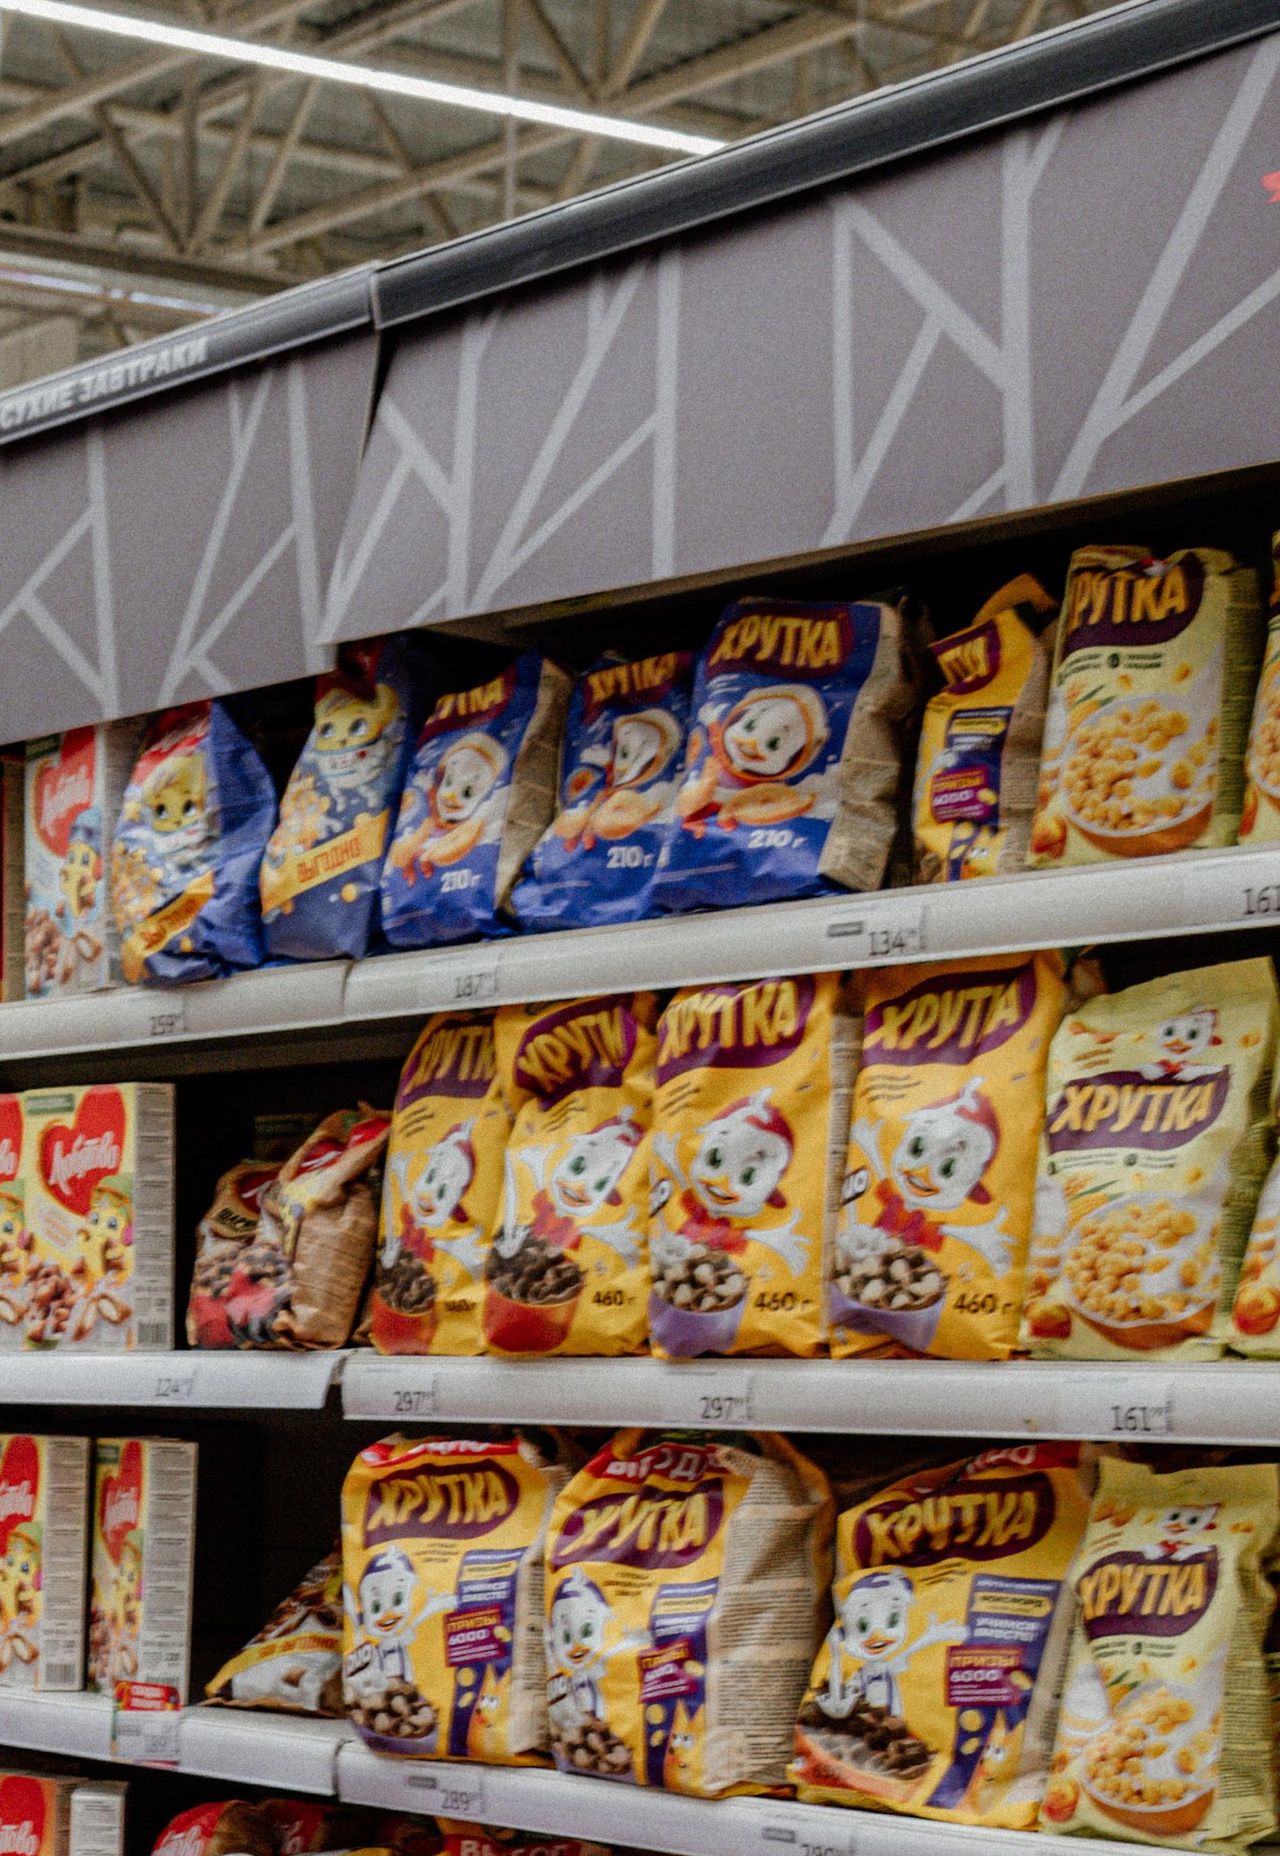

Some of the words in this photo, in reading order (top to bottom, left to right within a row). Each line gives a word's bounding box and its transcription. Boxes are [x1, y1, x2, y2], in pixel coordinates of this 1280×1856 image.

[0, 383, 78, 430] СУХИЕ
[79, 338, 209, 402] ЗАВТРАКИ
[1070, 566, 1188, 631] РУТКА
[711, 614, 843, 669] ХРУТКА
[606, 846, 642, 870] 210
[747, 829, 787, 850] 210
[440, 868, 472, 894] 210
[659, 980, 797, 1066] ХРУТКА
[1049, 1080, 1215, 1134] ХРУТКА
[592, 1290, 624, 1308] 460
[753, 1291, 797, 1313] 460
[952, 1293, 997, 1315] 460
[367, 1470, 510, 1531] ХРУТКА
[865, 1490, 1038, 1567] ХРУТКА
[1079, 1562, 1207, 1617] ХРУТКА
[949, 1655, 1017, 1668] ПРИЗЫ
[950, 1668, 1002, 1683] 6000
